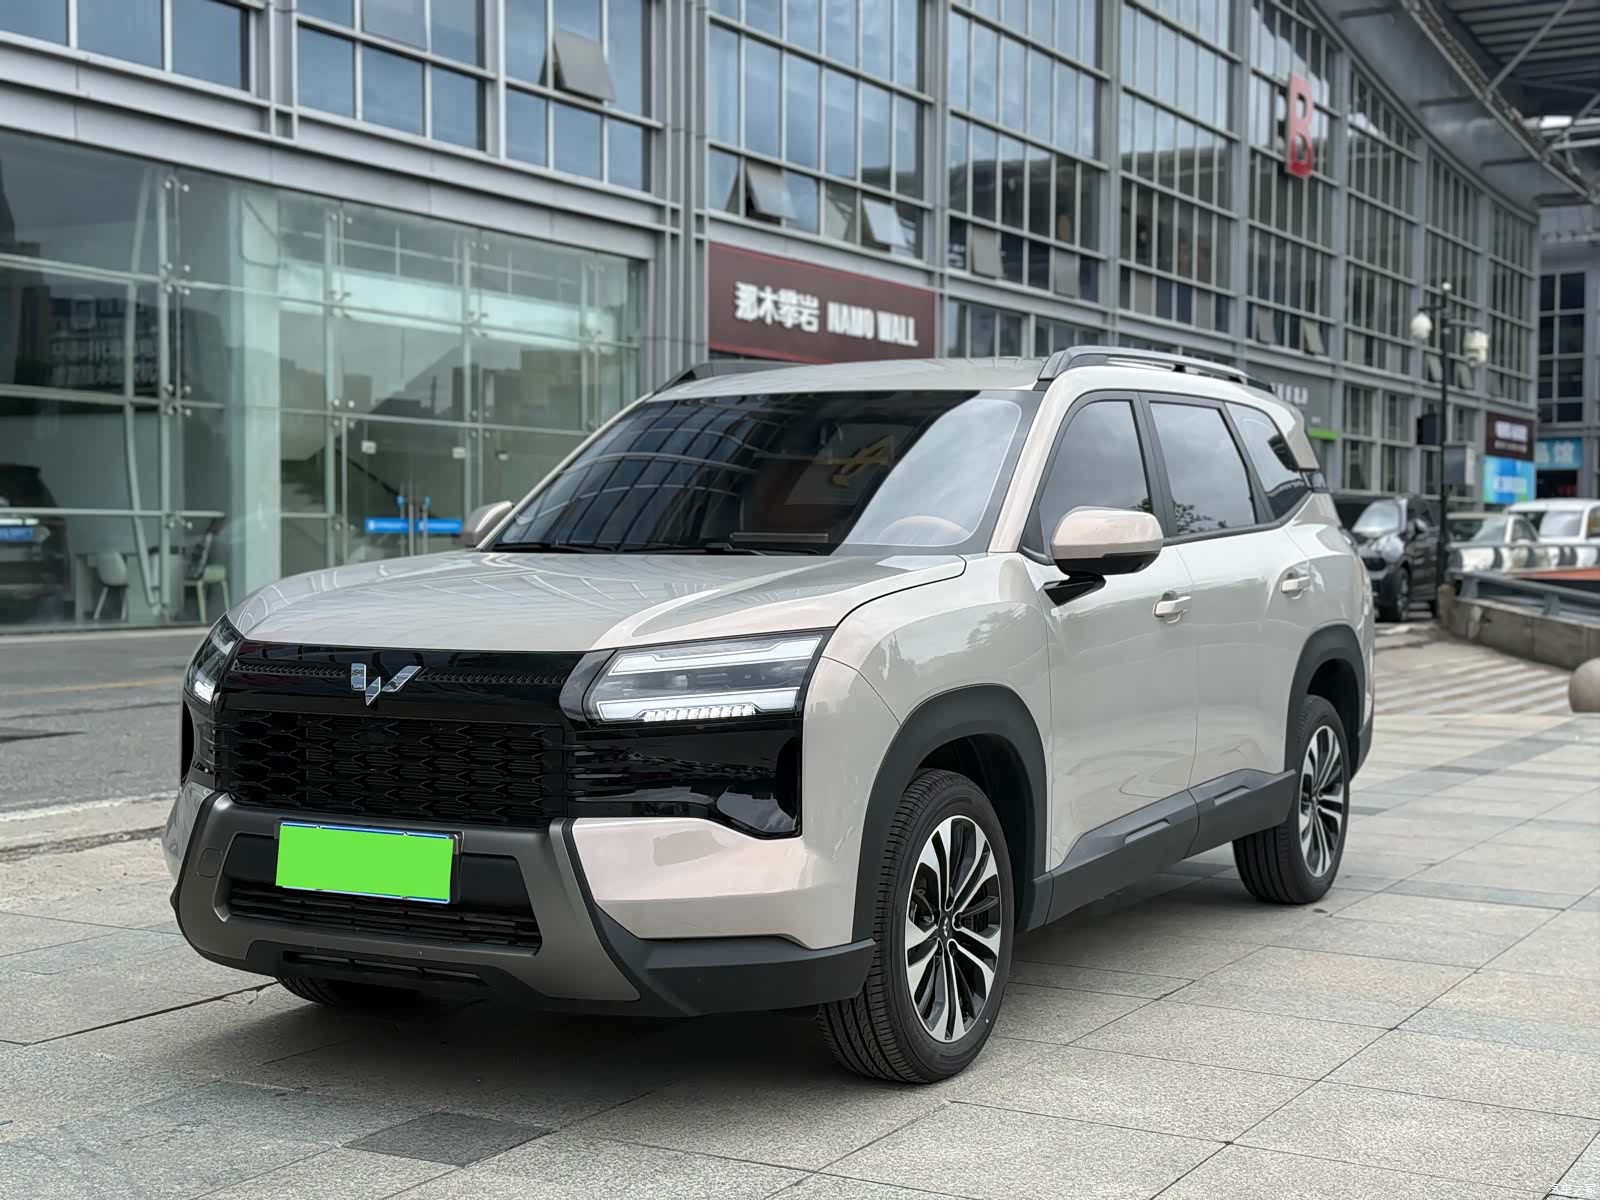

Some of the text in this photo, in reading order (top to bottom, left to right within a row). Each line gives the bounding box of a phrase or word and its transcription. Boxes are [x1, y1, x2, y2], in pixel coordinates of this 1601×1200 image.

[1287, 72, 1314, 178] B
[735, 281, 820, 333] 那木攀岩
[877, 311, 918, 346] WALL
